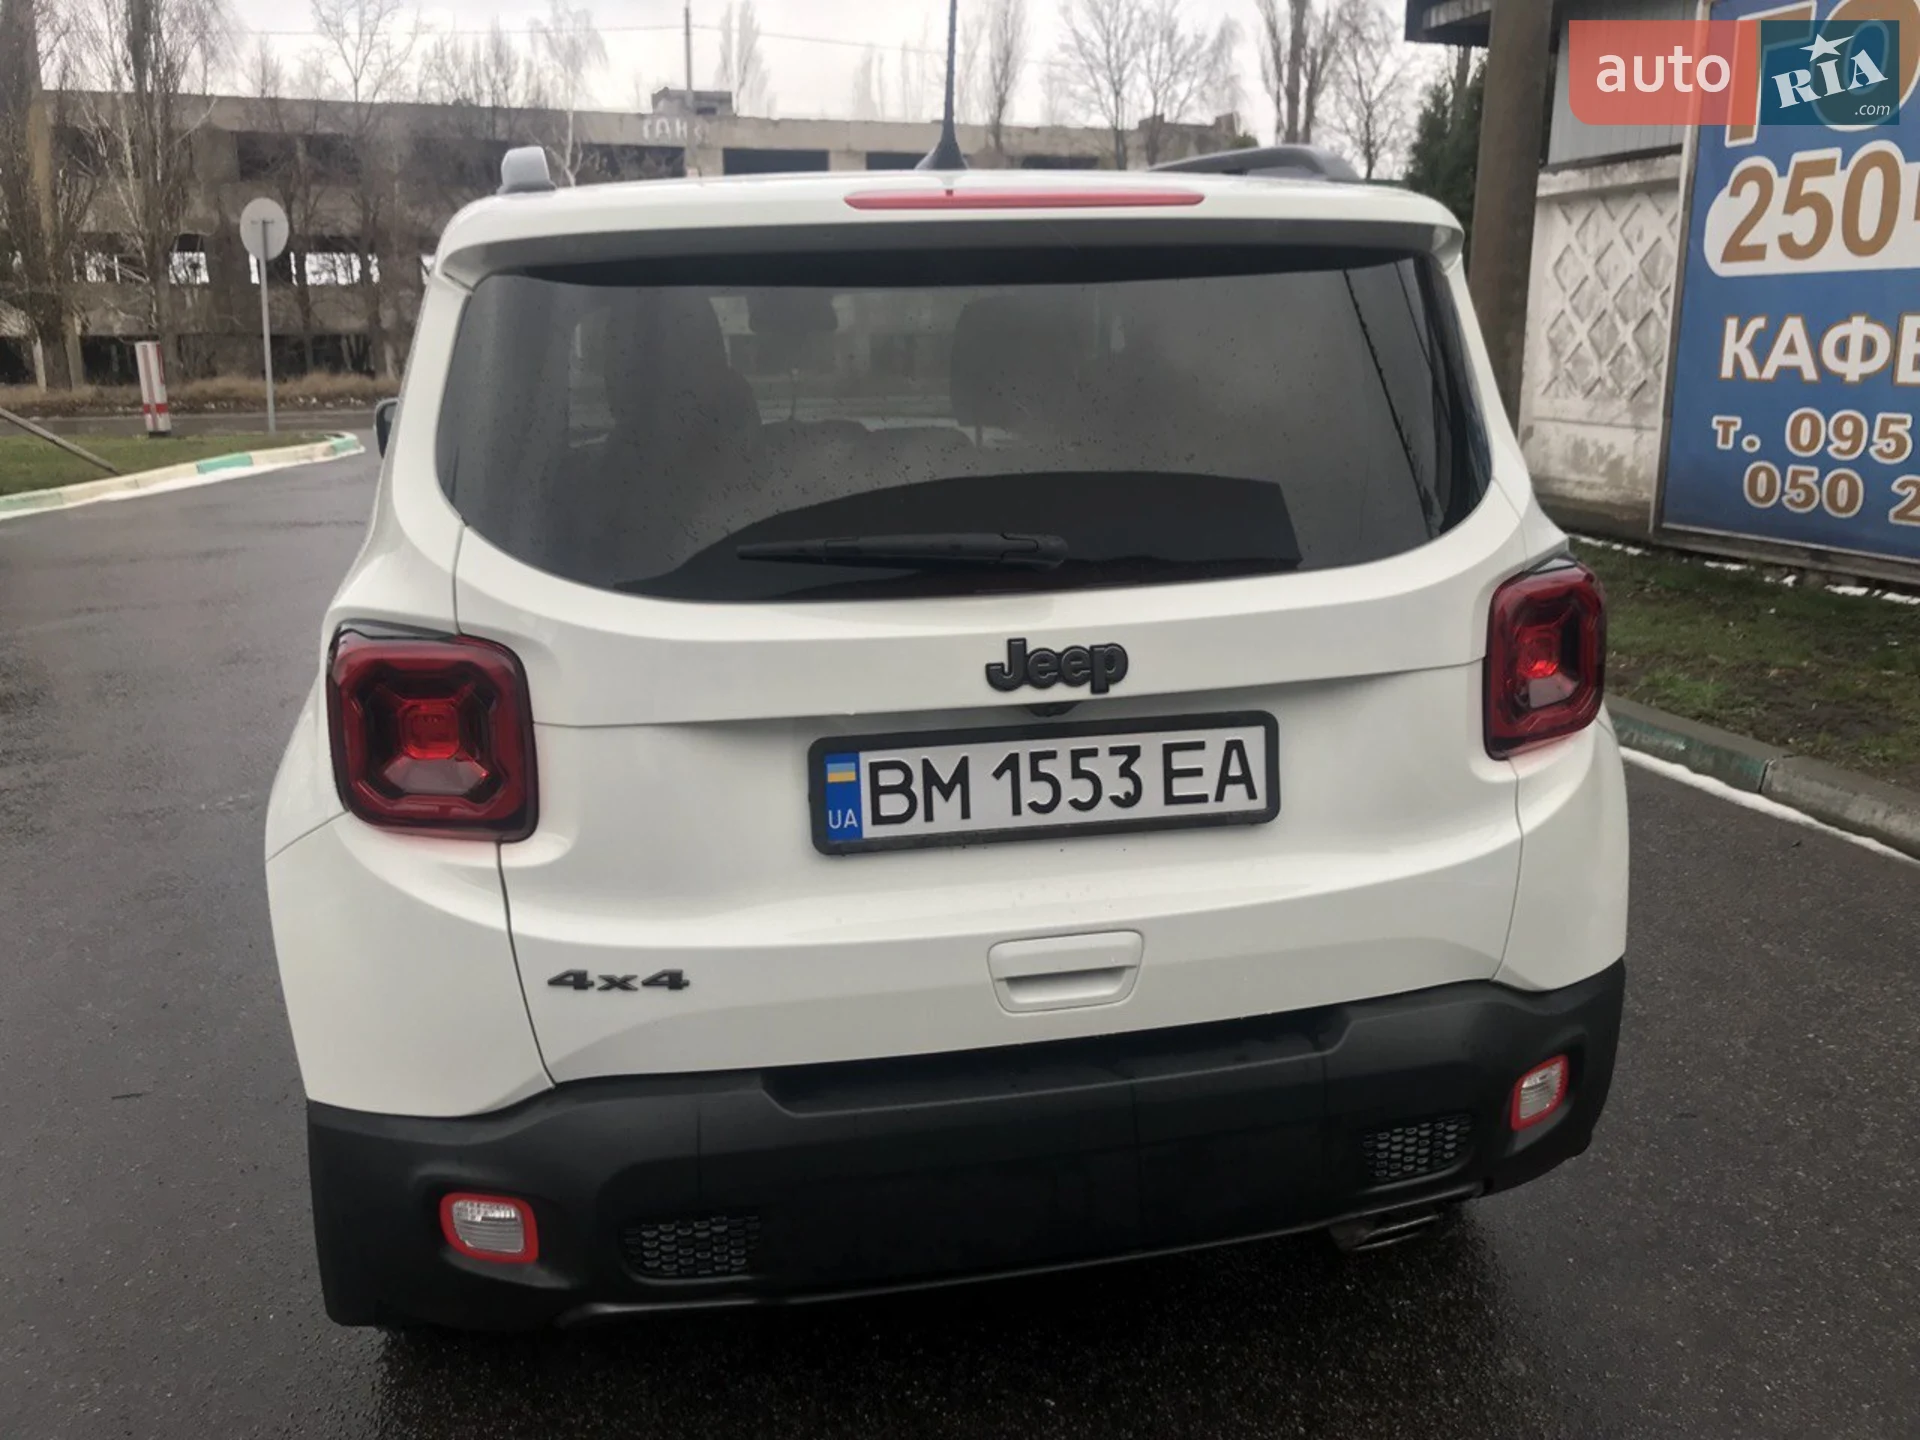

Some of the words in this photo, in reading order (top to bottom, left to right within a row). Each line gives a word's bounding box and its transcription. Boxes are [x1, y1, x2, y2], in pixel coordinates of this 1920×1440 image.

[1785, 407, 1913, 465] 095
[1743, 460, 1864, 519] 050
[985, 637, 1129, 695] Jeep
[868, 756, 971, 826] BM
[991, 744, 1143, 817] 1553
[1162, 738, 1258, 806] EA
[828, 808, 858, 829] UA
[546, 968, 690, 991] 4x4
